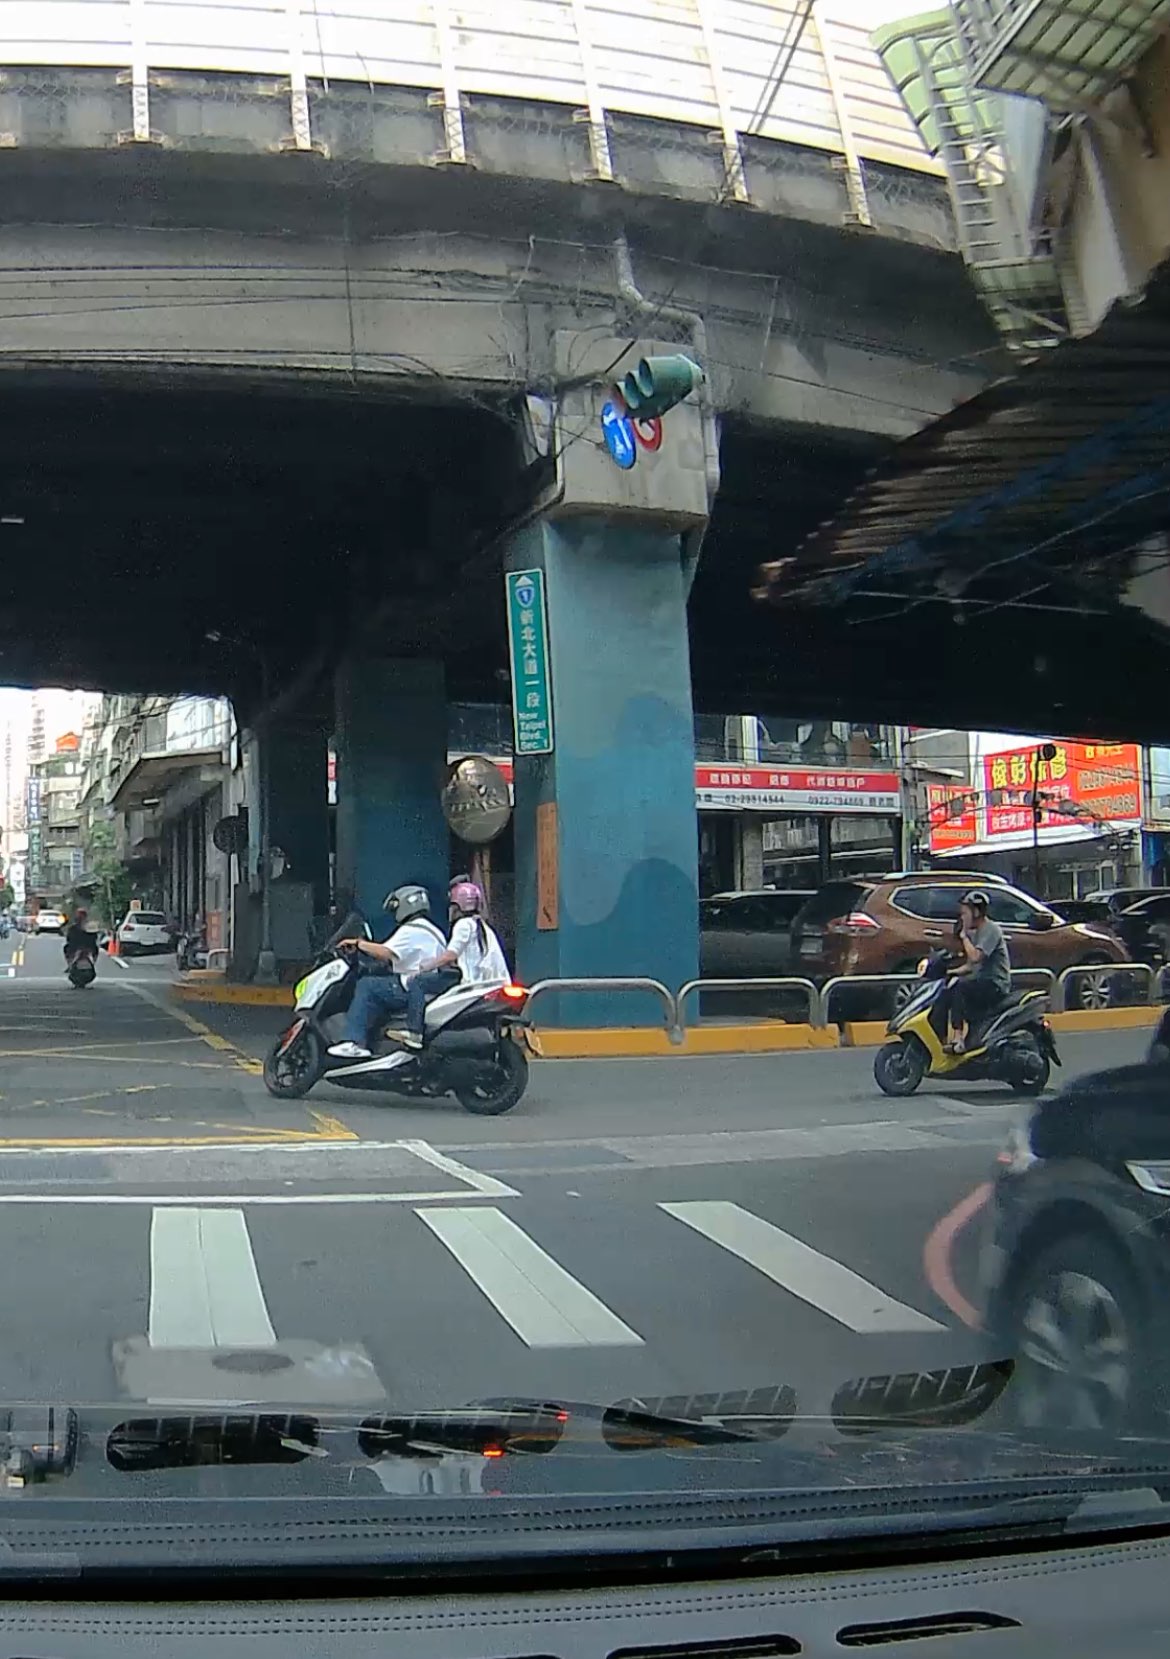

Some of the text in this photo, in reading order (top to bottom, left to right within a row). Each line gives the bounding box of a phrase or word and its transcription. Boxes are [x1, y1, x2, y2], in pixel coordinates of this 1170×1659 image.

[521, 590, 529, 602] 1
[520, 608, 541, 708] 新北大道一段
[518, 712, 538, 720] New
[520, 720, 546, 731] Taipei
